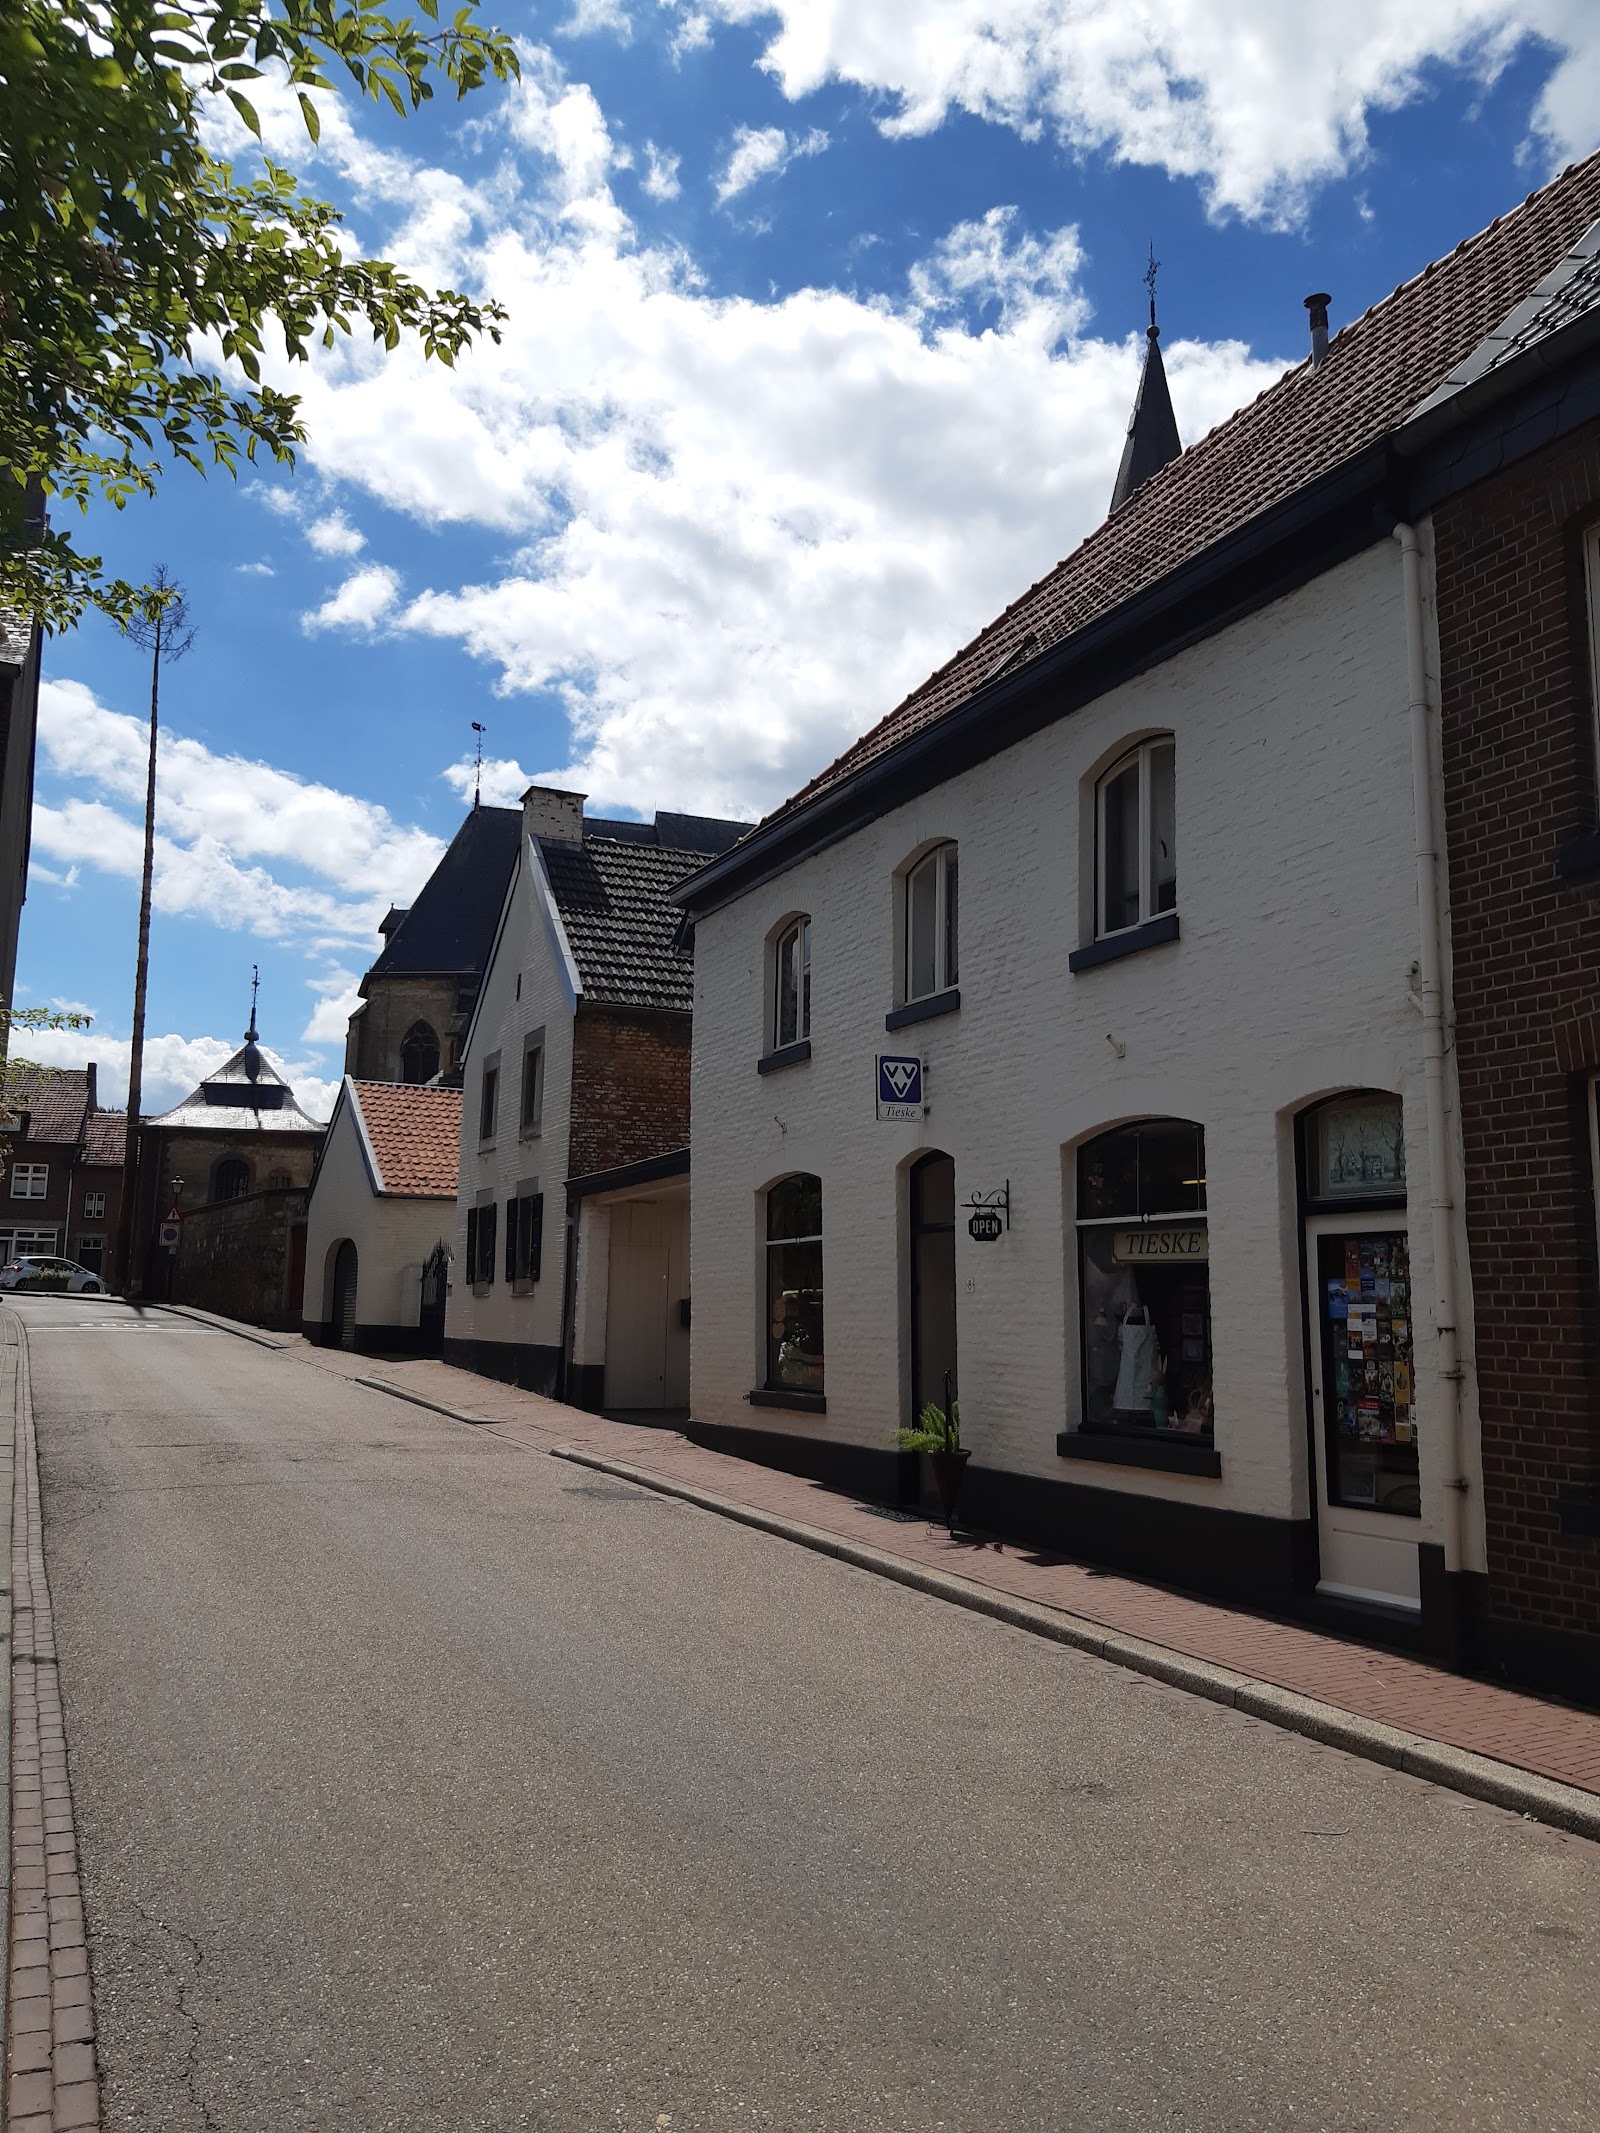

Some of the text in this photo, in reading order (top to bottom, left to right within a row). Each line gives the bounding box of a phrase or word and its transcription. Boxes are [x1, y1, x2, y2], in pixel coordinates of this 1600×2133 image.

[886, 1105, 916, 1118] Tieske
[972, 1219, 998, 1234] OPEN
[1126, 1231, 1201, 1255] TIESKE
